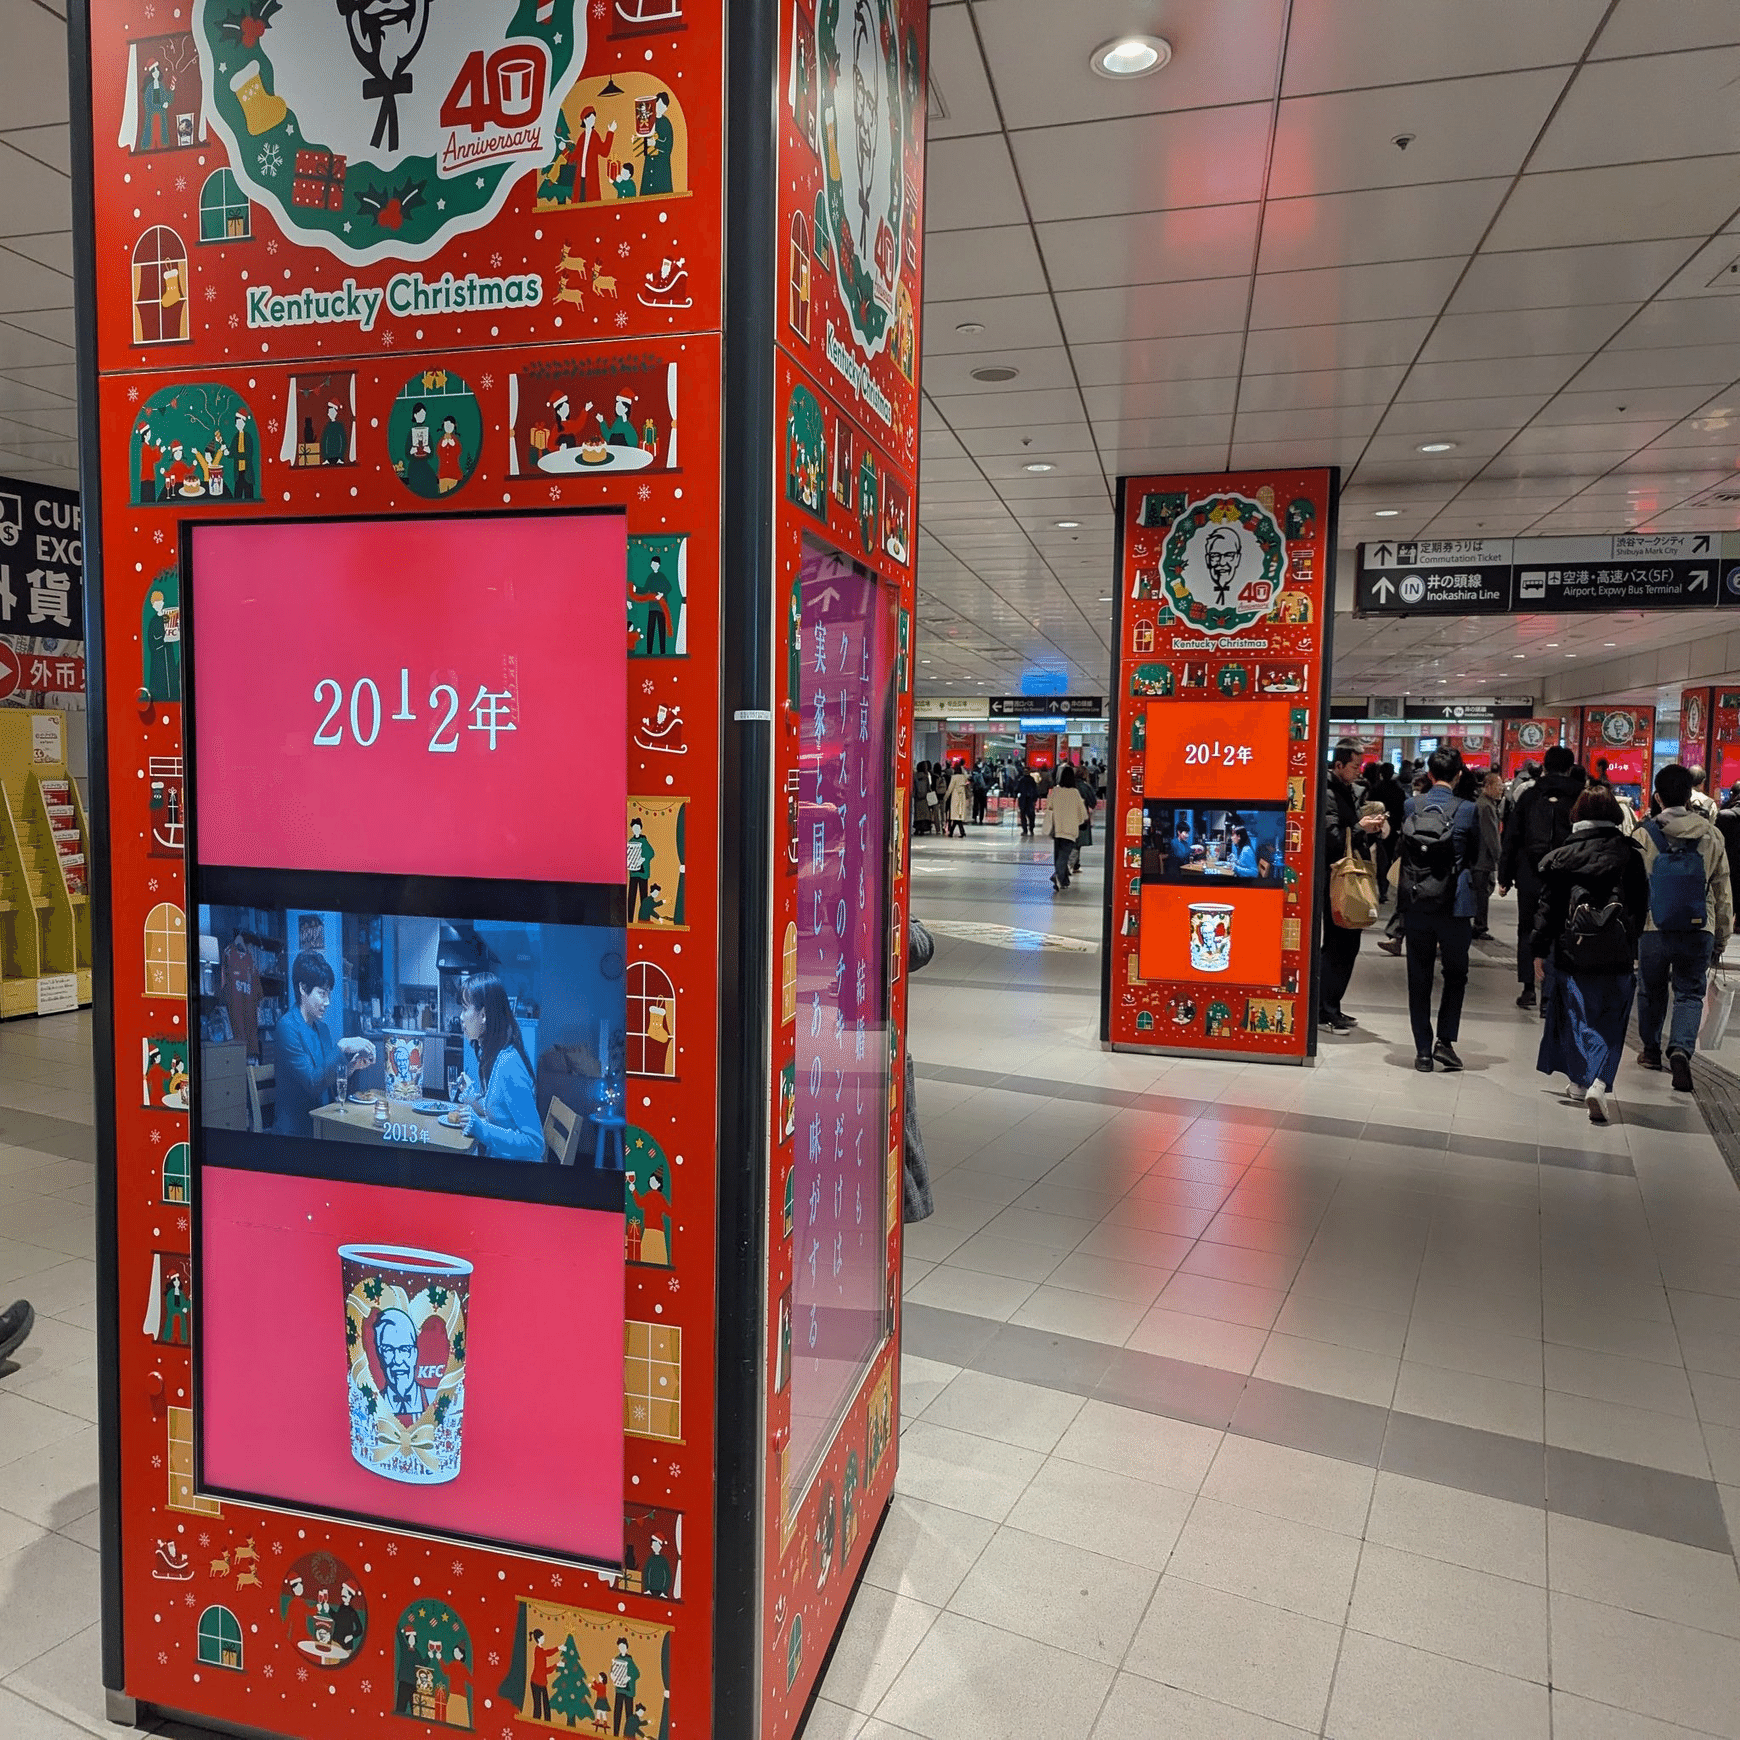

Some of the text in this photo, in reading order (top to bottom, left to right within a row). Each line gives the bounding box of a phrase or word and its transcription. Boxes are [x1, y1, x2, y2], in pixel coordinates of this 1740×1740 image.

[440, 44, 547, 133] 40
[443, 126, 541, 164] Anniversary
[249, 277, 539, 326] Kentucky Christmas
[827, 322, 892, 425] Kentucky Christmas
[1420, 541, 1483, 554] 定期券うりば
[1616, 547, 1644, 557] Shibuya
[1664, 546, 1678, 555] City
[1419, 553, 1502, 565] Commutation Ticket
[1404, 583, 1420, 595] IN
[1427, 573, 1482, 590] 井の頭線
[1237, 581, 1271, 603] 40
[1427, 589, 1501, 601] Inokashira Line
[1563, 583, 1682, 598] Airport, Expwy Bus Terminal
[1173, 638, 1266, 651] Kentucky Christmas
[312, 667, 518, 753] 2012年
[1184, 740, 1254, 766] 2012年
[383, 1121, 430, 1144] 2013年
[417, 1363, 445, 1380] KFC
